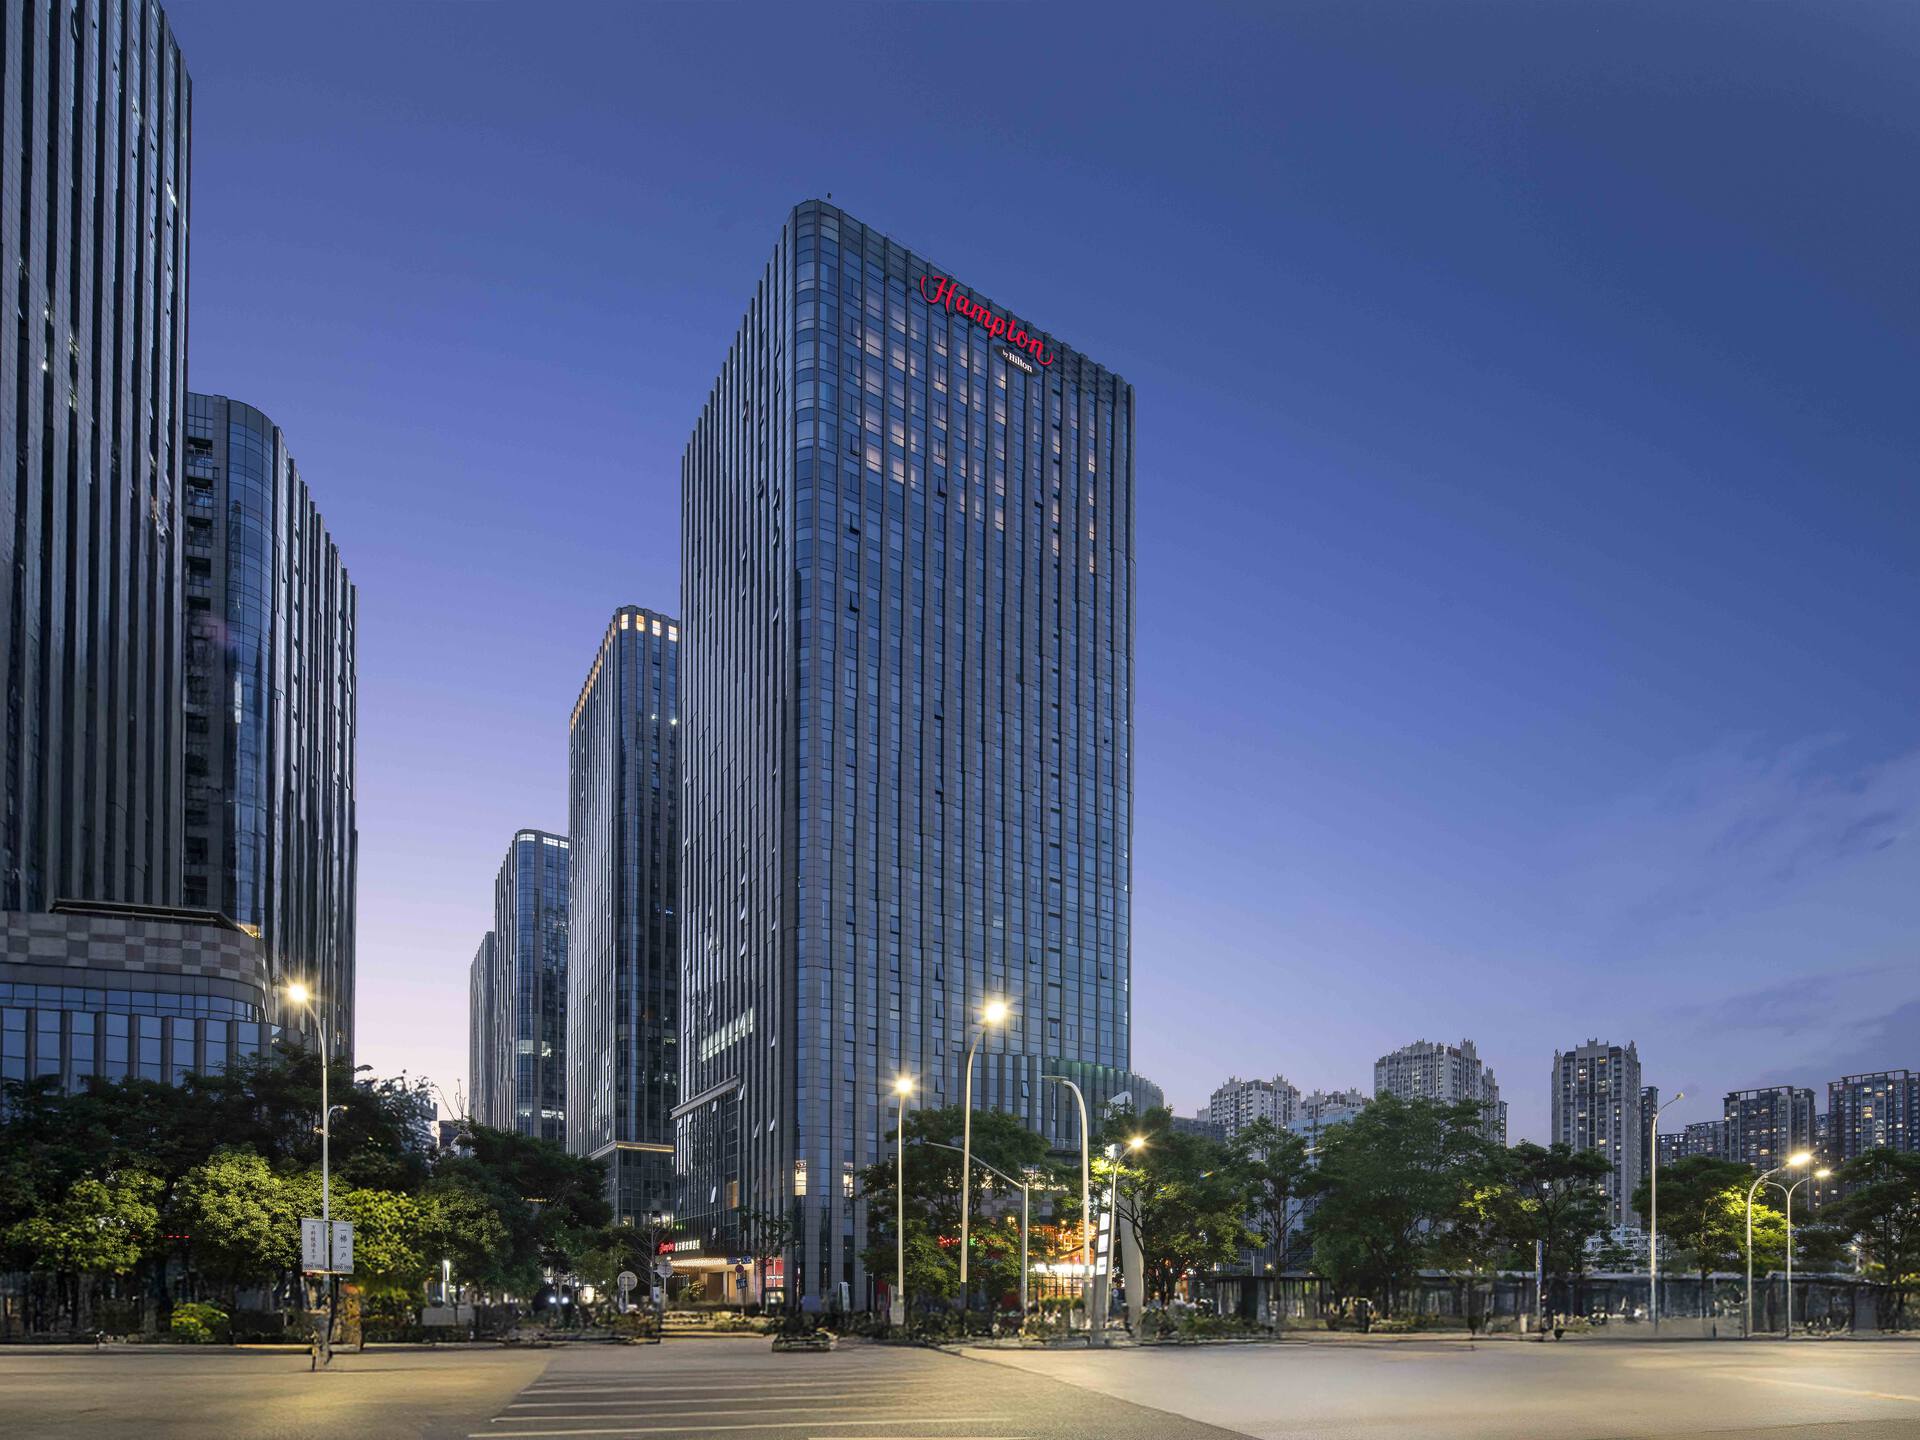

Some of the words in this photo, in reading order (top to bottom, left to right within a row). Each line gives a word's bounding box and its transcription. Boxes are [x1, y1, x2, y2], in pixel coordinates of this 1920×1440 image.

[920, 275, 1054, 366] Hampton
[1002, 349, 1009, 358] by
[1008, 351, 1033, 373] Hilton
